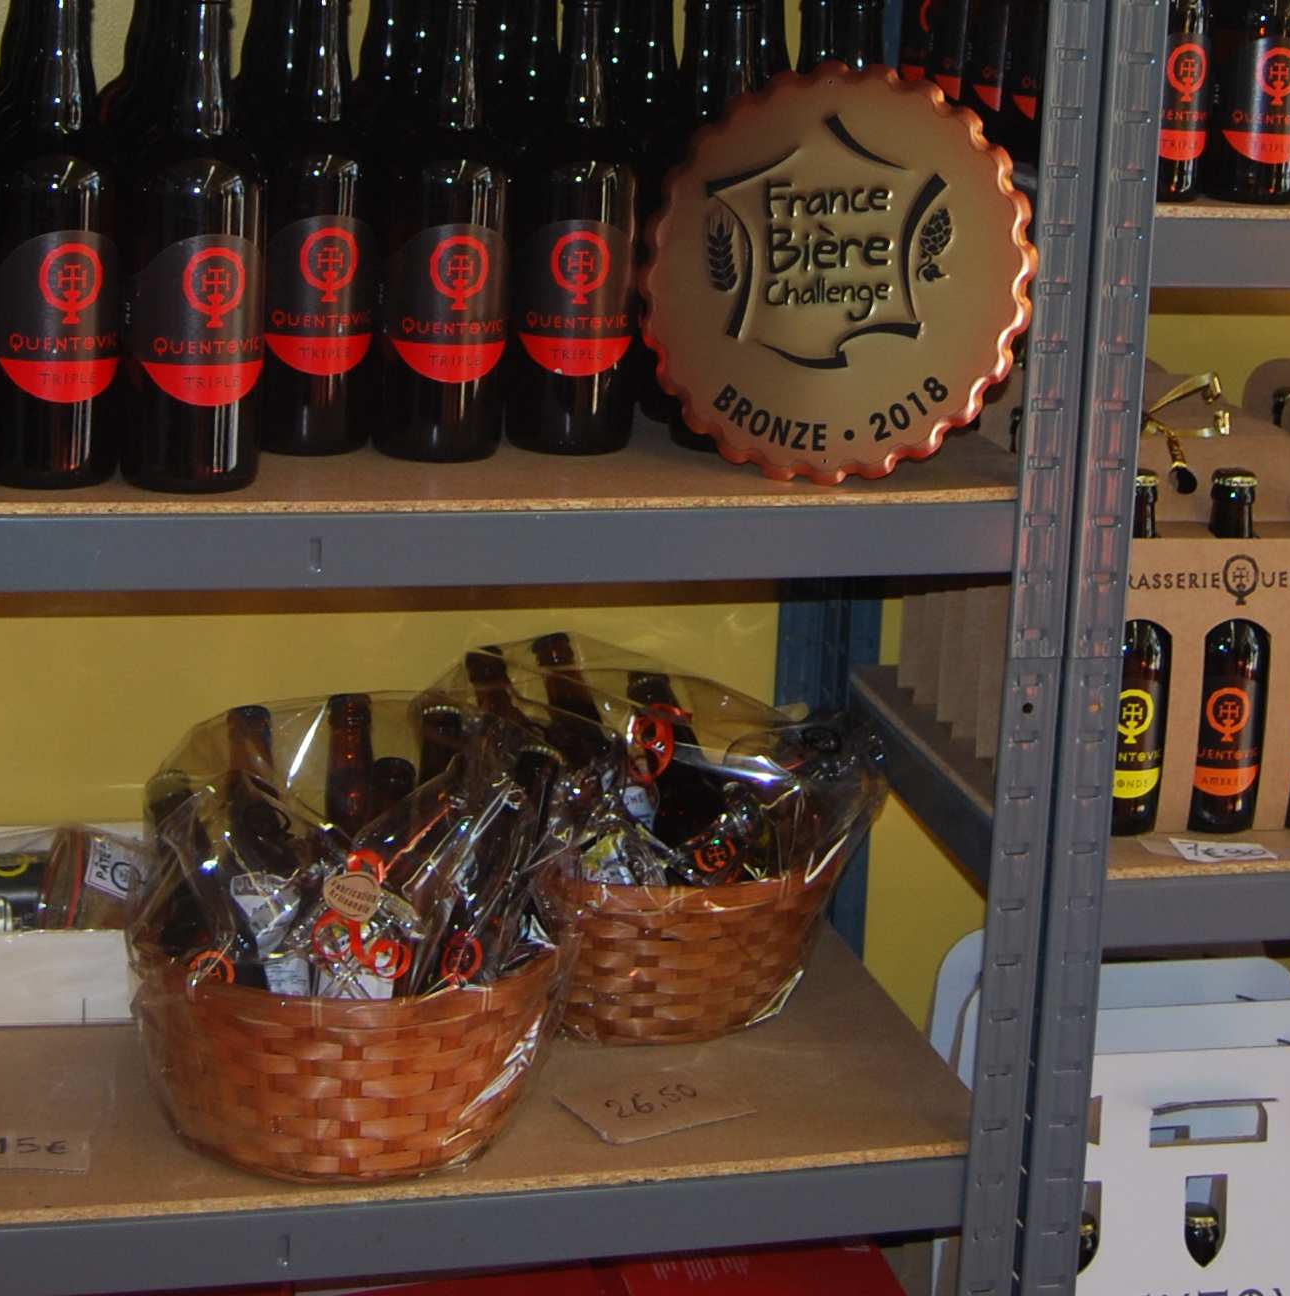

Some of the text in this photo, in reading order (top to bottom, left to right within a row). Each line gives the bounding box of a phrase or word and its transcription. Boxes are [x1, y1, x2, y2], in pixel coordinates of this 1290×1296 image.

[766, 179, 893, 218] France
[770, 225, 894, 273] Bière
[766, 277, 892, 322] Challenge
[402, 315, 503, 336] QUENTOVIC
[10, 333, 118, 354] QUENTOVIC
[153, 336, 260, 357] QUENTOVIC
[39, 372, 97, 386] TRIPLE
[184, 376, 241, 390] TRIPLE
[712, 376, 949, 452] BRONZE 2018
[1128, 569, 1221, 590] RASSERIE
